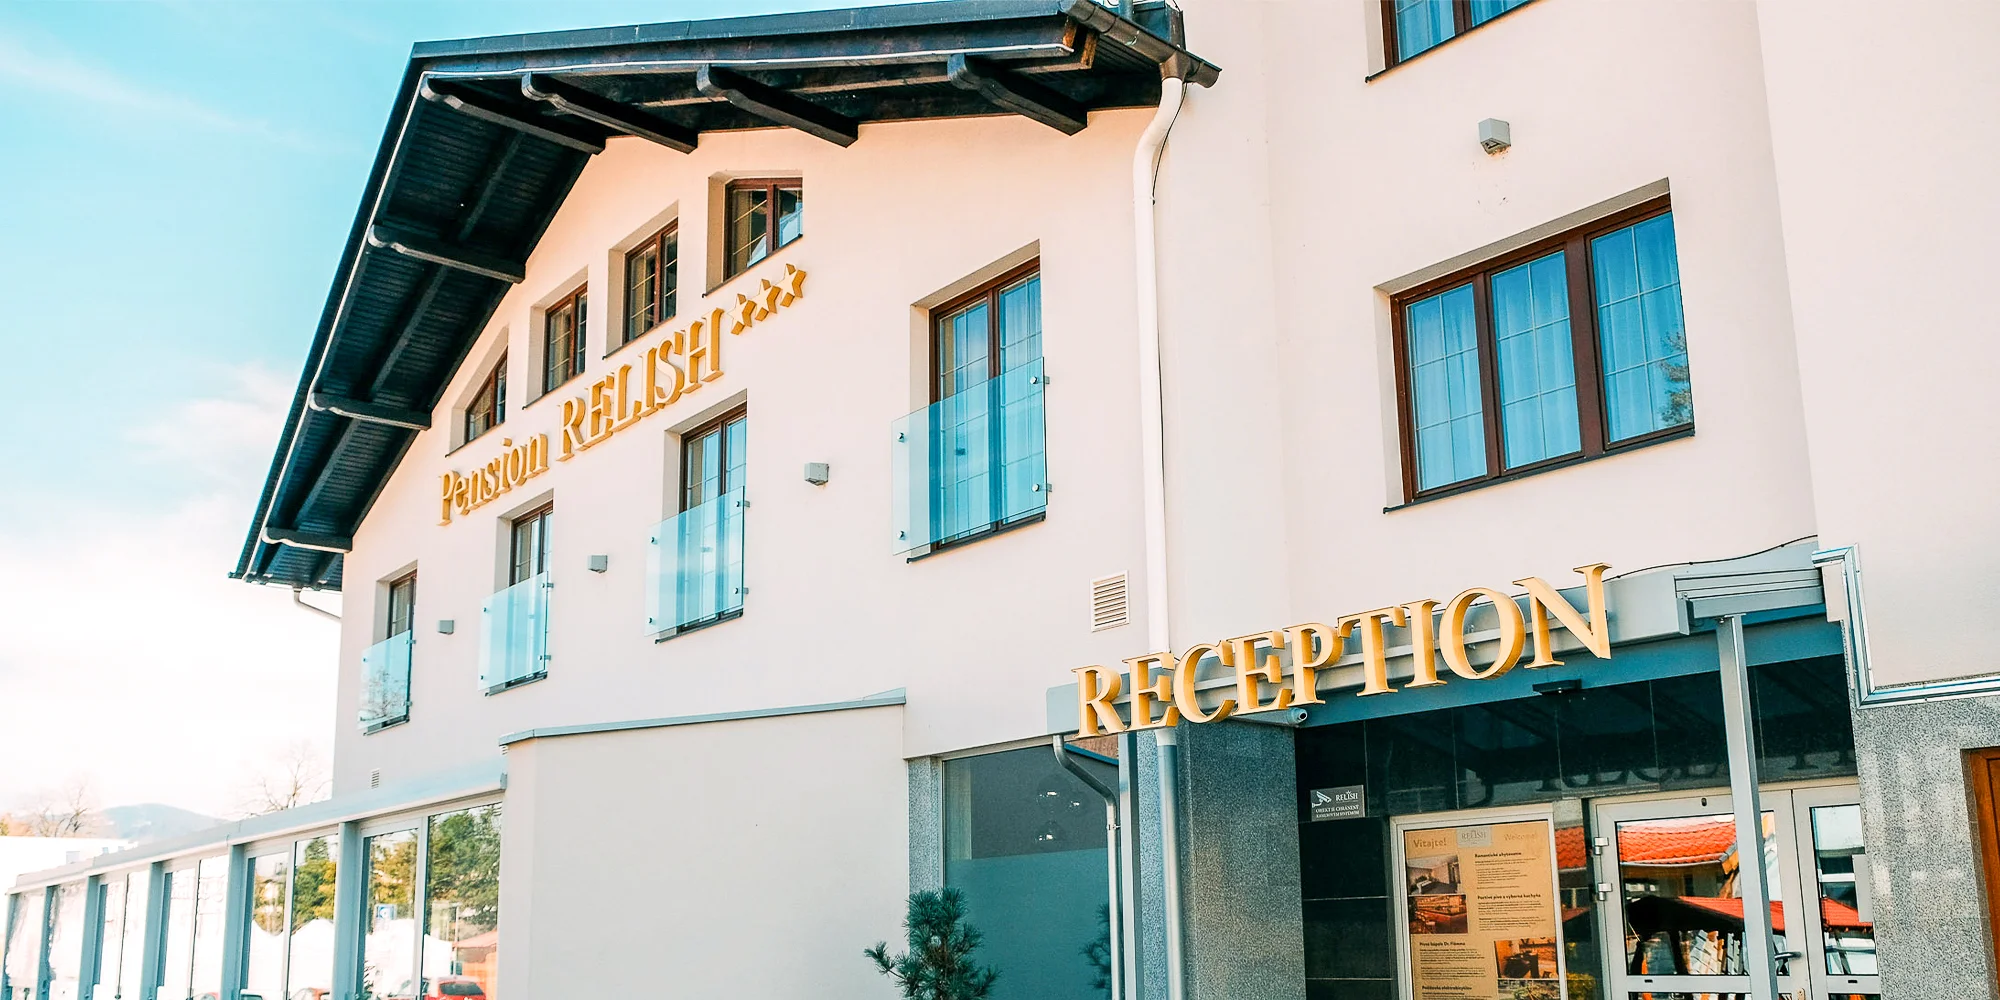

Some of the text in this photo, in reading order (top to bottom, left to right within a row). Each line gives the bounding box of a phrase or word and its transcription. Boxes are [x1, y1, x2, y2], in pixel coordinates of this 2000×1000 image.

[437, 308, 724, 526] Pension RELISH
[1071, 562, 1613, 740] RECEPTION
[1335, 792, 1358, 801] RELISH
[1413, 837, 1447, 849] Vitajte!
